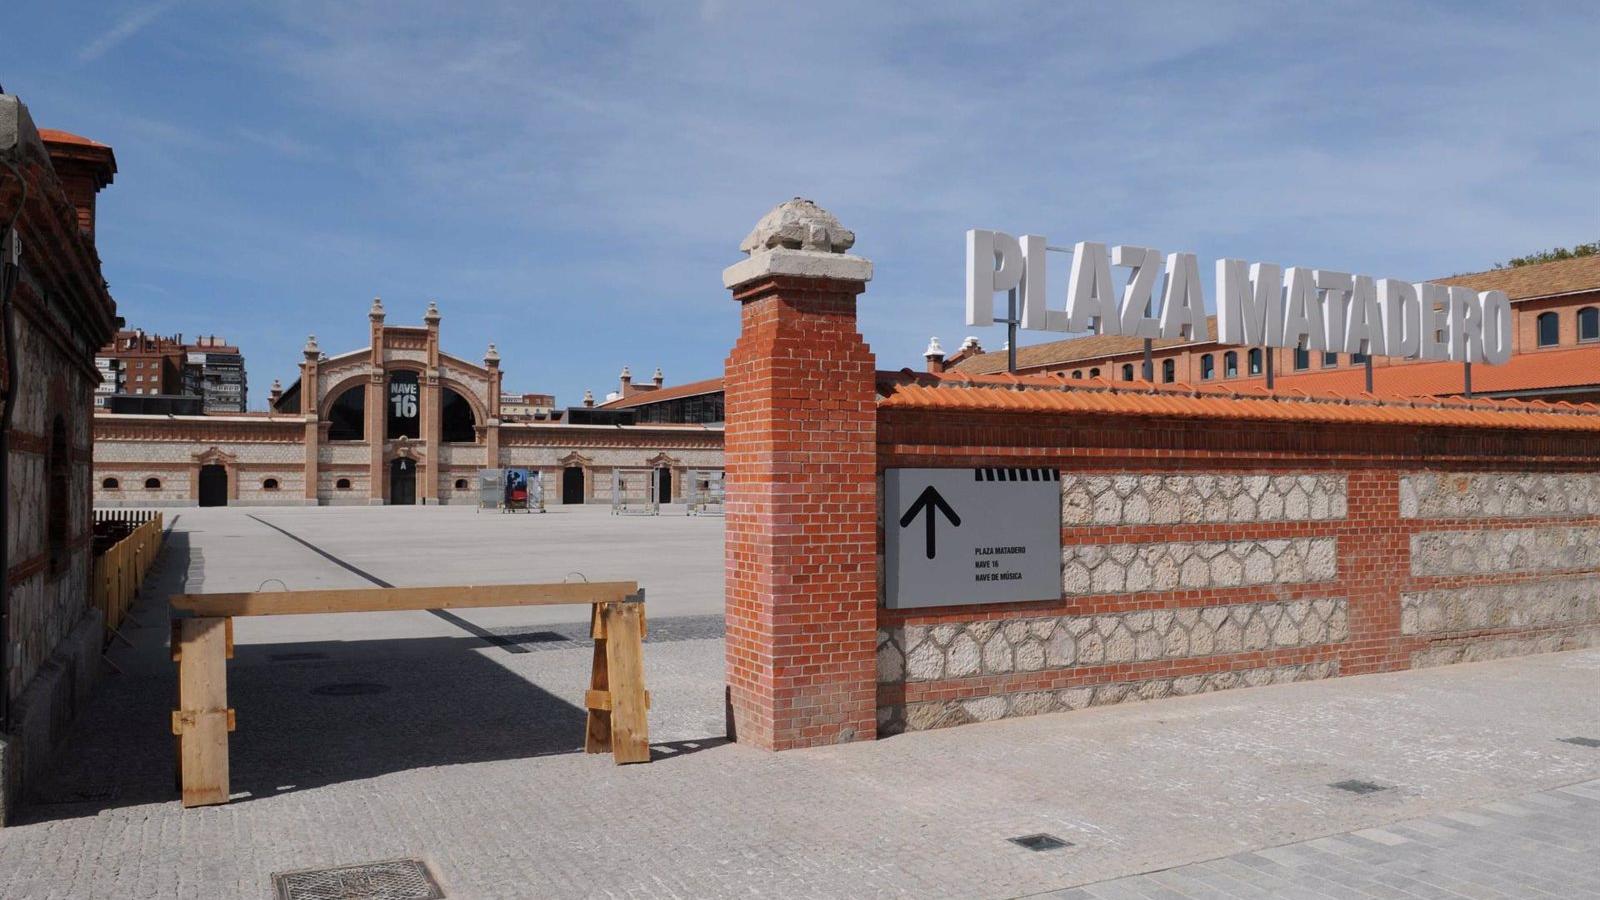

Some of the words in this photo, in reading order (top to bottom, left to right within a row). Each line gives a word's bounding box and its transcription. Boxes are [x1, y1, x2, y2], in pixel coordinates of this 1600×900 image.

[966, 229, 1207, 341] PLAZA
[1216, 259, 1512, 365] MATADERO
[391, 383, 417, 394] NAVE
[391, 394, 417, 418] 16
[400, 461, 407, 470] A
[975, 547, 994, 555] PLAZA
[995, 546, 1025, 555] MATADERO
[975, 560, 990, 568] NAVE
[992, 560, 999, 568] 16
[975, 573, 990, 582] NAVE
[991, 573, 999, 581] DE
[1000, 570, 1023, 580] MÚSICA
